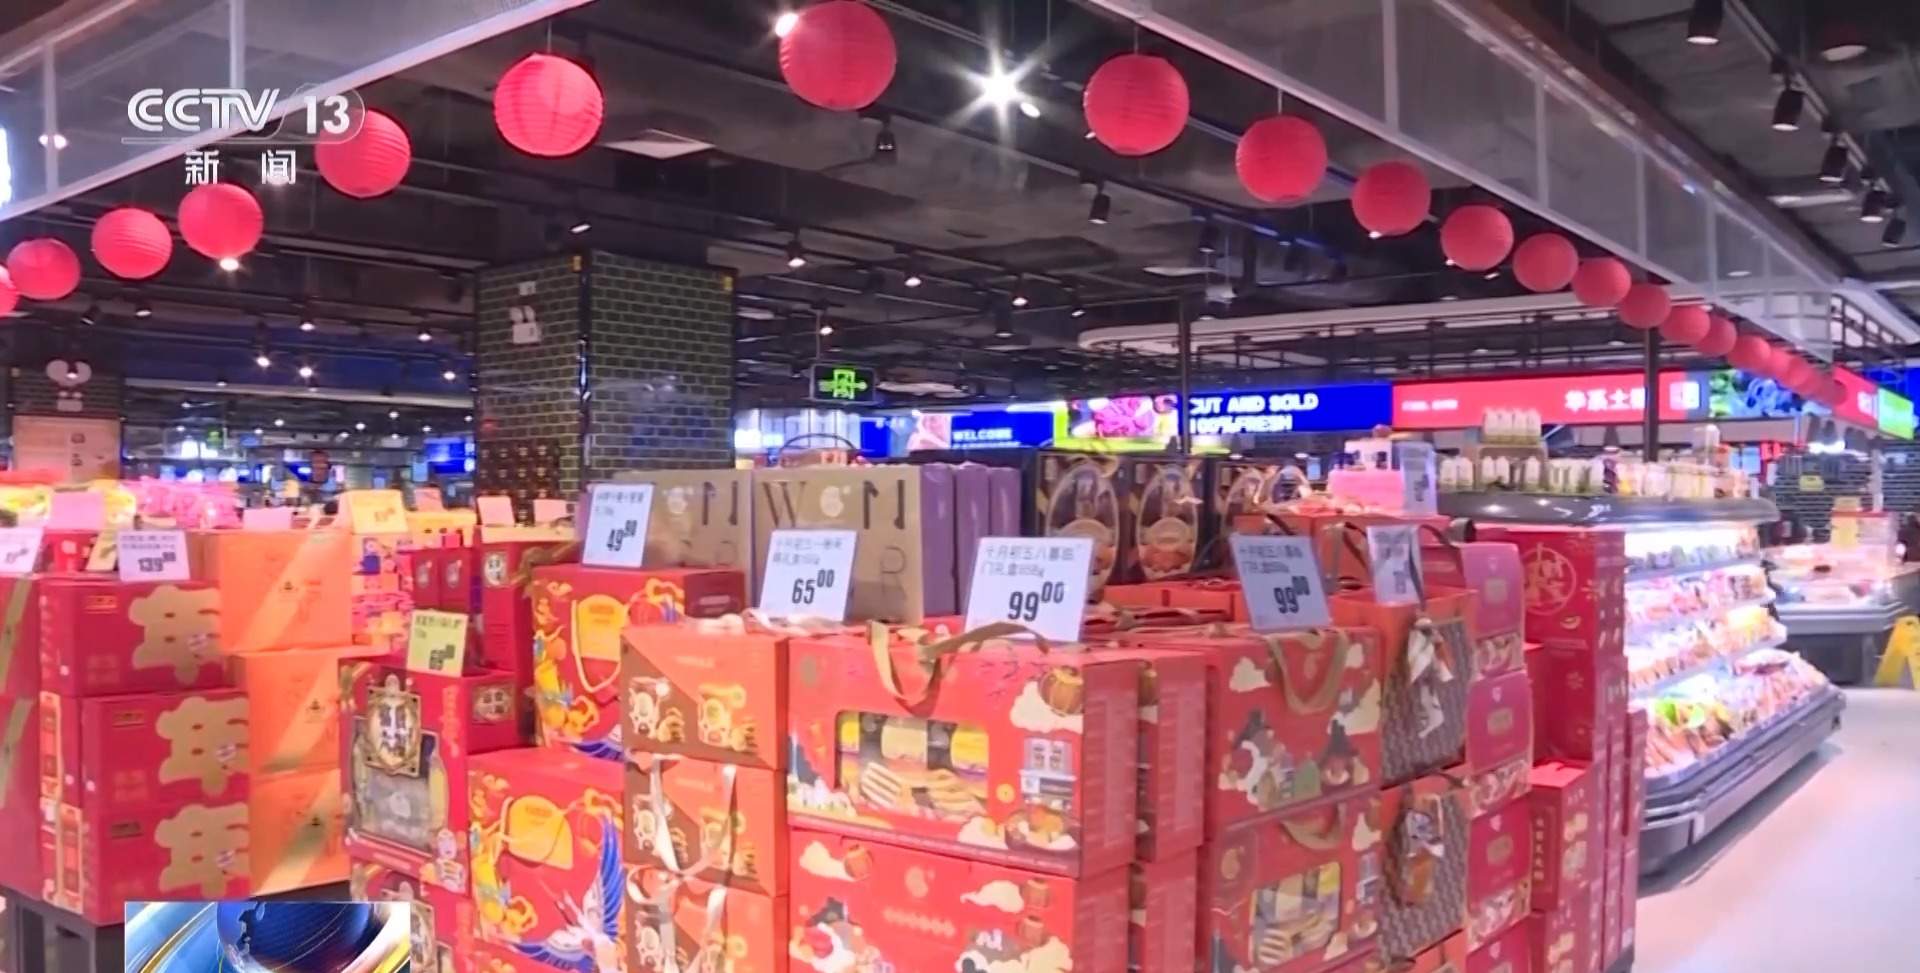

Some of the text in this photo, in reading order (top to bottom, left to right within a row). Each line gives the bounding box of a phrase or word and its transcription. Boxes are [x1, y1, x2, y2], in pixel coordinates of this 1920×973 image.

[1226, 395, 1266, 414] AND
[1268, 393, 1319, 412] SOLD
[791, 568, 836, 605] 65 00
[1007, 580, 1066, 622] 99 00
[1273, 586, 1300, 614] 99
